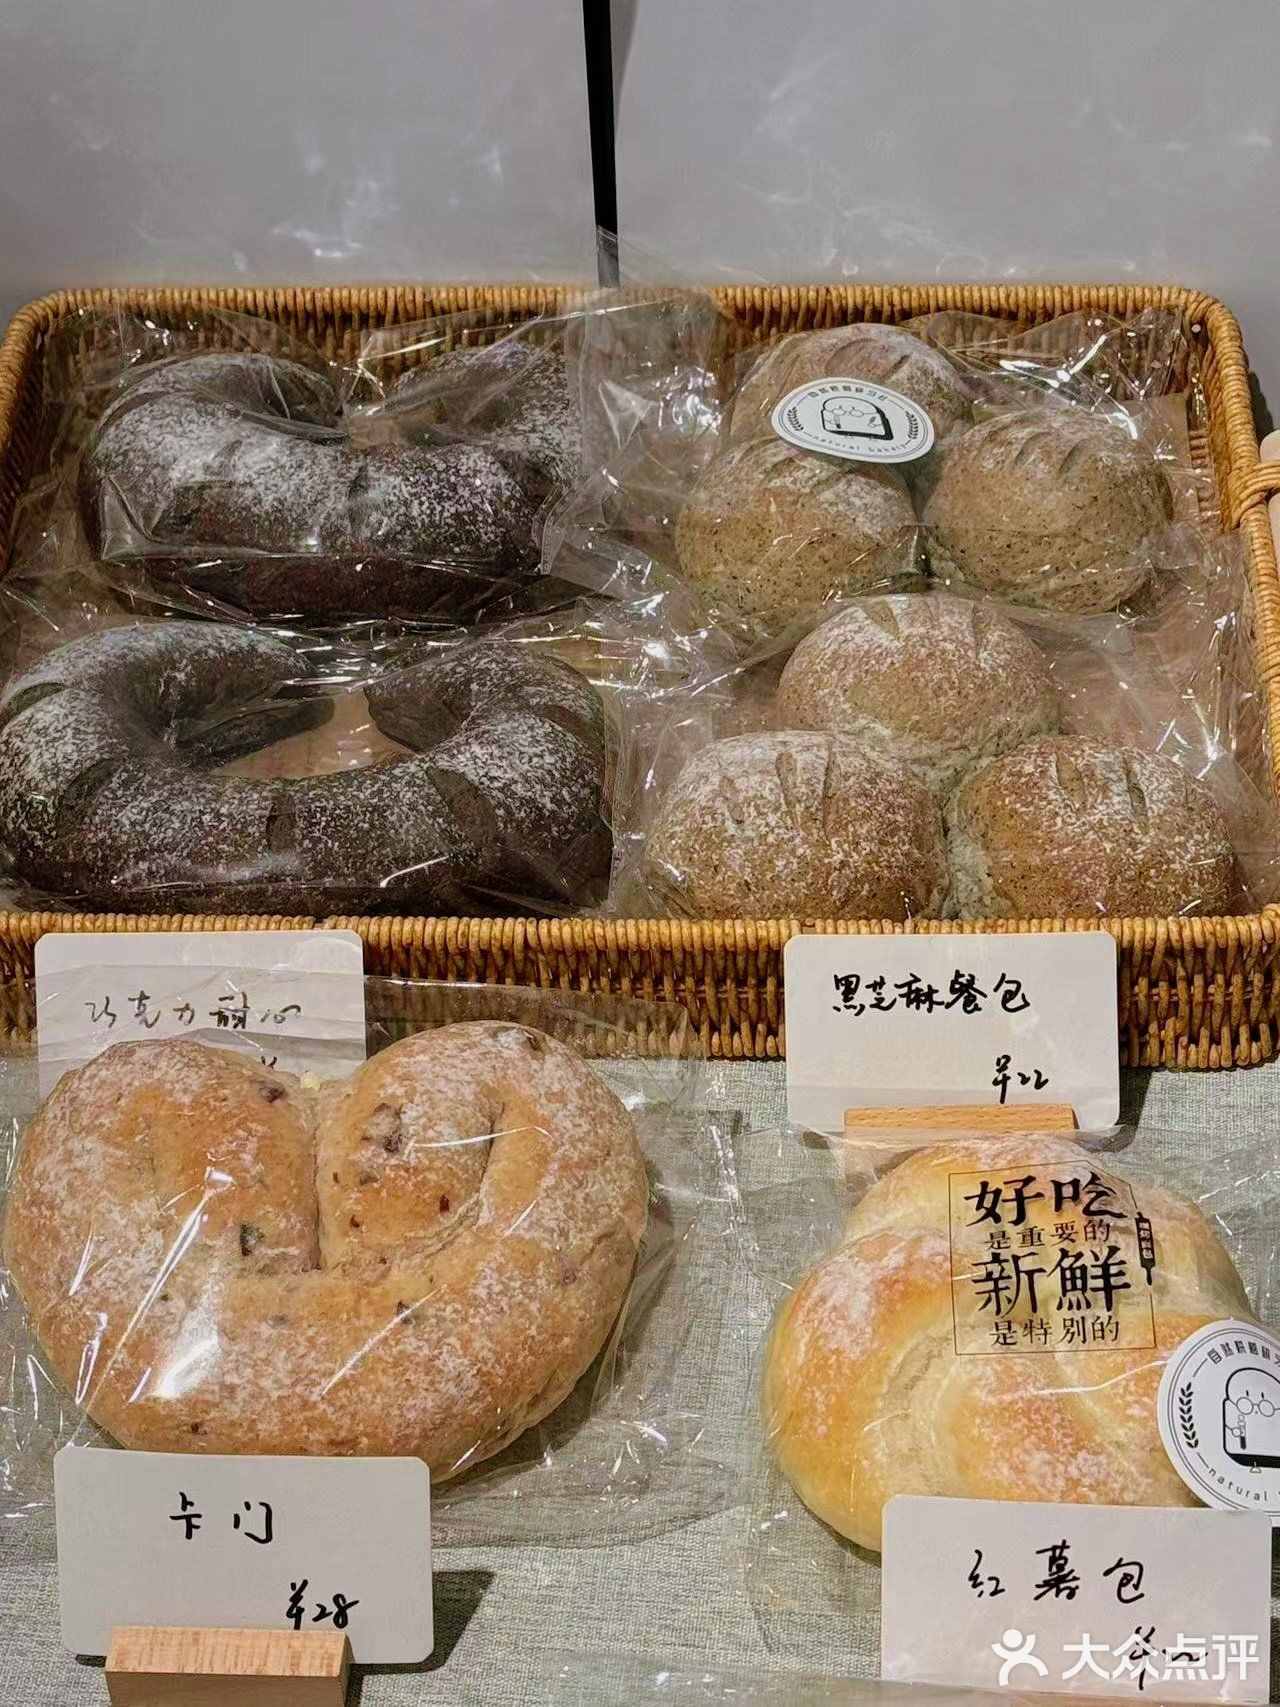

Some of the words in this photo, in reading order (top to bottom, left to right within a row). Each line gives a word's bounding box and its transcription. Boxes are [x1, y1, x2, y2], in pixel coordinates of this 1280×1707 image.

[813, 435, 861, 451] natural
[832, 969, 1031, 1017] 黑芝麻餐包
[963, 1171, 1128, 1228] 好吃
[984, 1218, 1111, 1251] 是重要的
[971, 1245, 1131, 1319] 新鮮
[1208, 1468, 1268, 1502] natural
[169, 1491, 273, 1544] 卡门
[286, 1579, 360, 1631] ¥28
